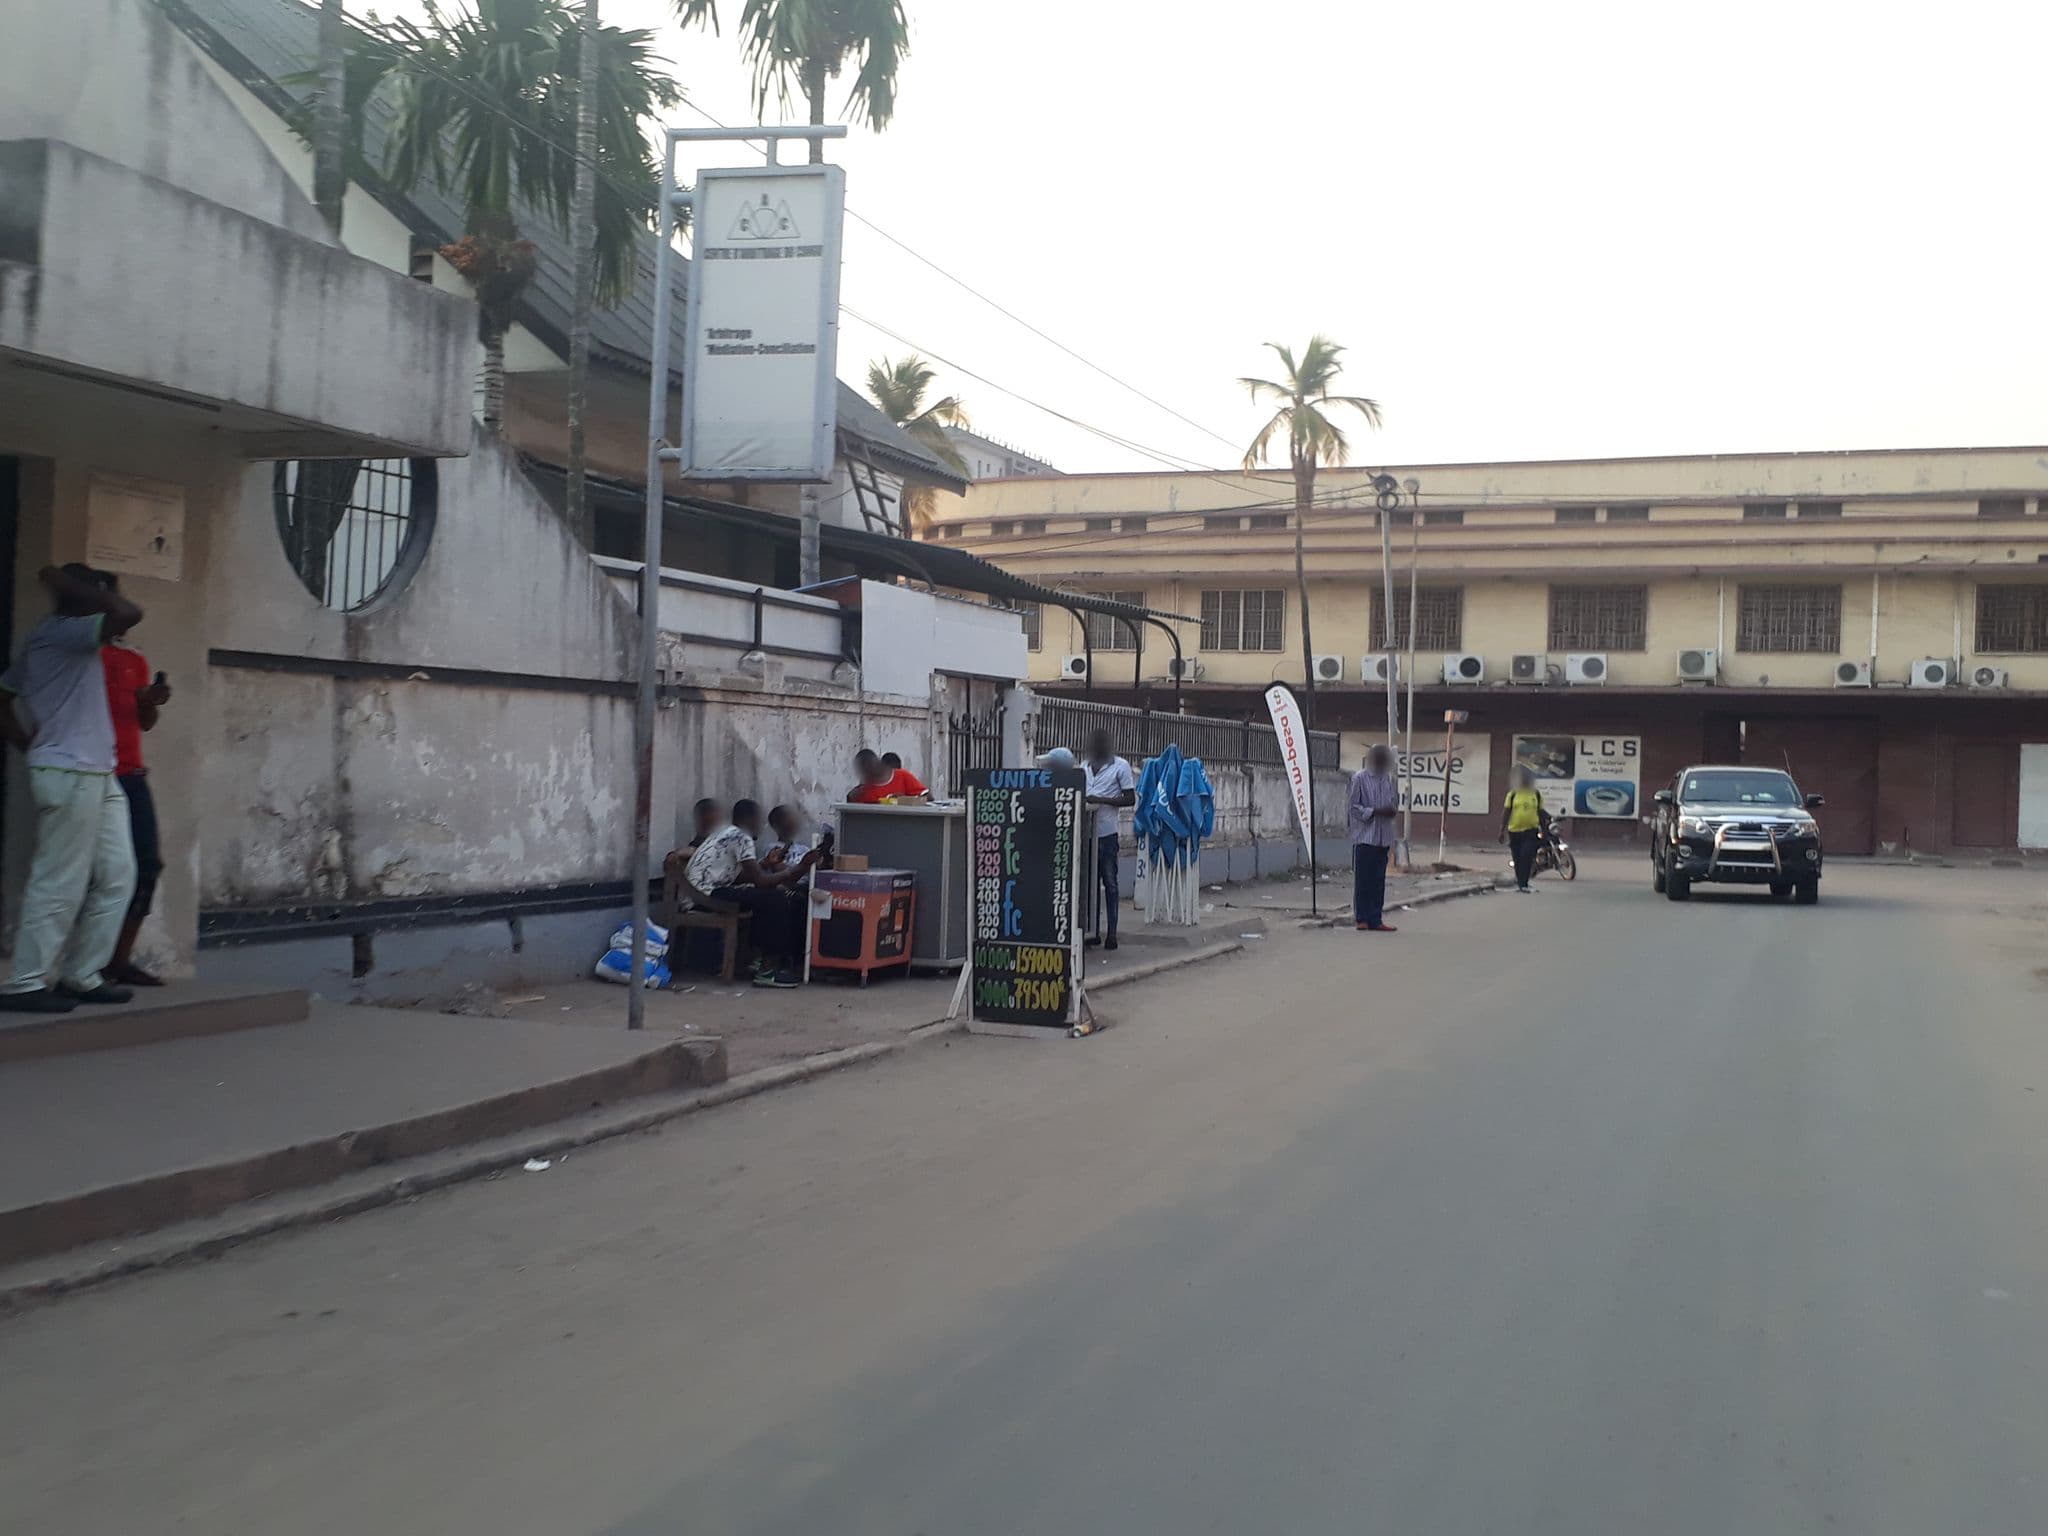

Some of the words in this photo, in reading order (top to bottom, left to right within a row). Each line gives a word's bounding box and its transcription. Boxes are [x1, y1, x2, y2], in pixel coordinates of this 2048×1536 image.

[976, 788, 1009, 801] 2000
[1054, 787, 1075, 802] 125
[976, 800, 1004, 812] 1500
[976, 812, 1006, 824] 1000
[1055, 814, 1071, 828] 63
[975, 824, 1001, 838] 900
[976, 839, 1000, 852] 800
[976, 852, 1001, 866] 700
[976, 864, 1000, 877] 600
[977, 877, 1000, 890] 500
[1053, 879, 1067, 893] 31
[976, 889, 1000, 904] 400
[1052, 892, 1069, 905] 25
[977, 902, 1000, 916] 300
[1053, 902, 1067, 917] 18
[977, 915, 1000, 928] 200
[1055, 916, 1068, 930] 12
[978, 926, 999, 940] 100
[1057, 928, 1066, 943] 6
[1015, 945, 1064, 974] 159000
[1013, 977, 1060, 1012] 79500
